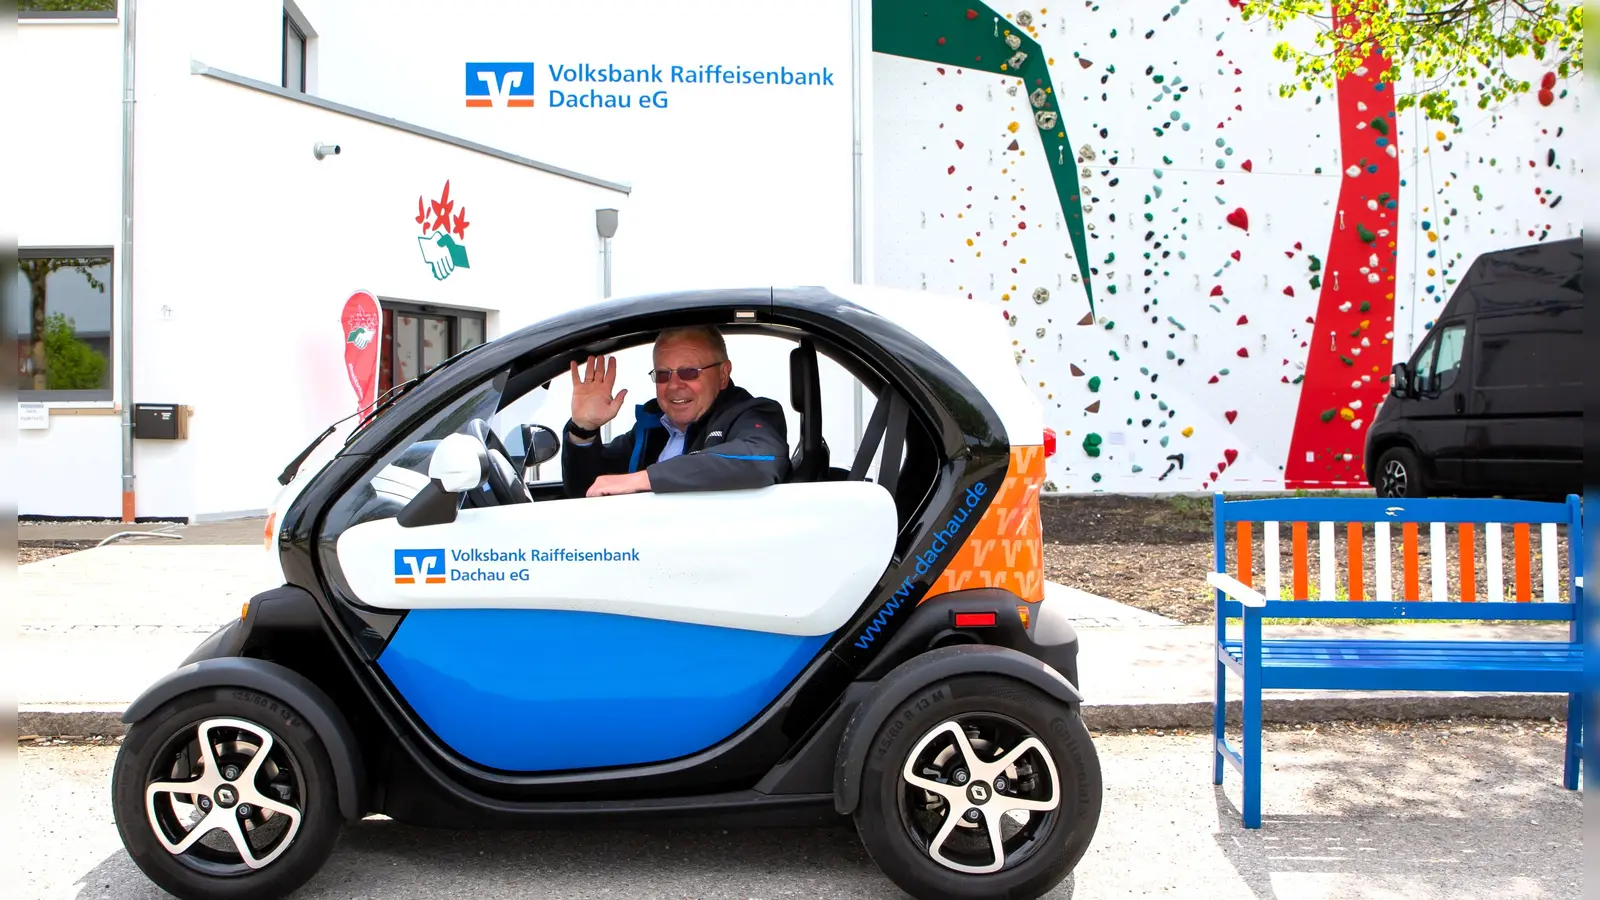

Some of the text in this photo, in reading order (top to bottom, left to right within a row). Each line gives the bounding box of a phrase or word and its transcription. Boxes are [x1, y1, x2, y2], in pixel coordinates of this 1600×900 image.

[548, 63, 835, 87] Volksbank Raiffeisenbank
[549, 88, 669, 110] Dachau eG
[450, 547, 641, 563] Volksbank Raiffeisenbank
[855, 481, 987, 649] www.vr-dachau.de
[450, 567, 530, 583] Dachau eG
[903, 710, 915, 721] R
[915, 698, 930, 712] 13
[931, 690, 945, 704] M
